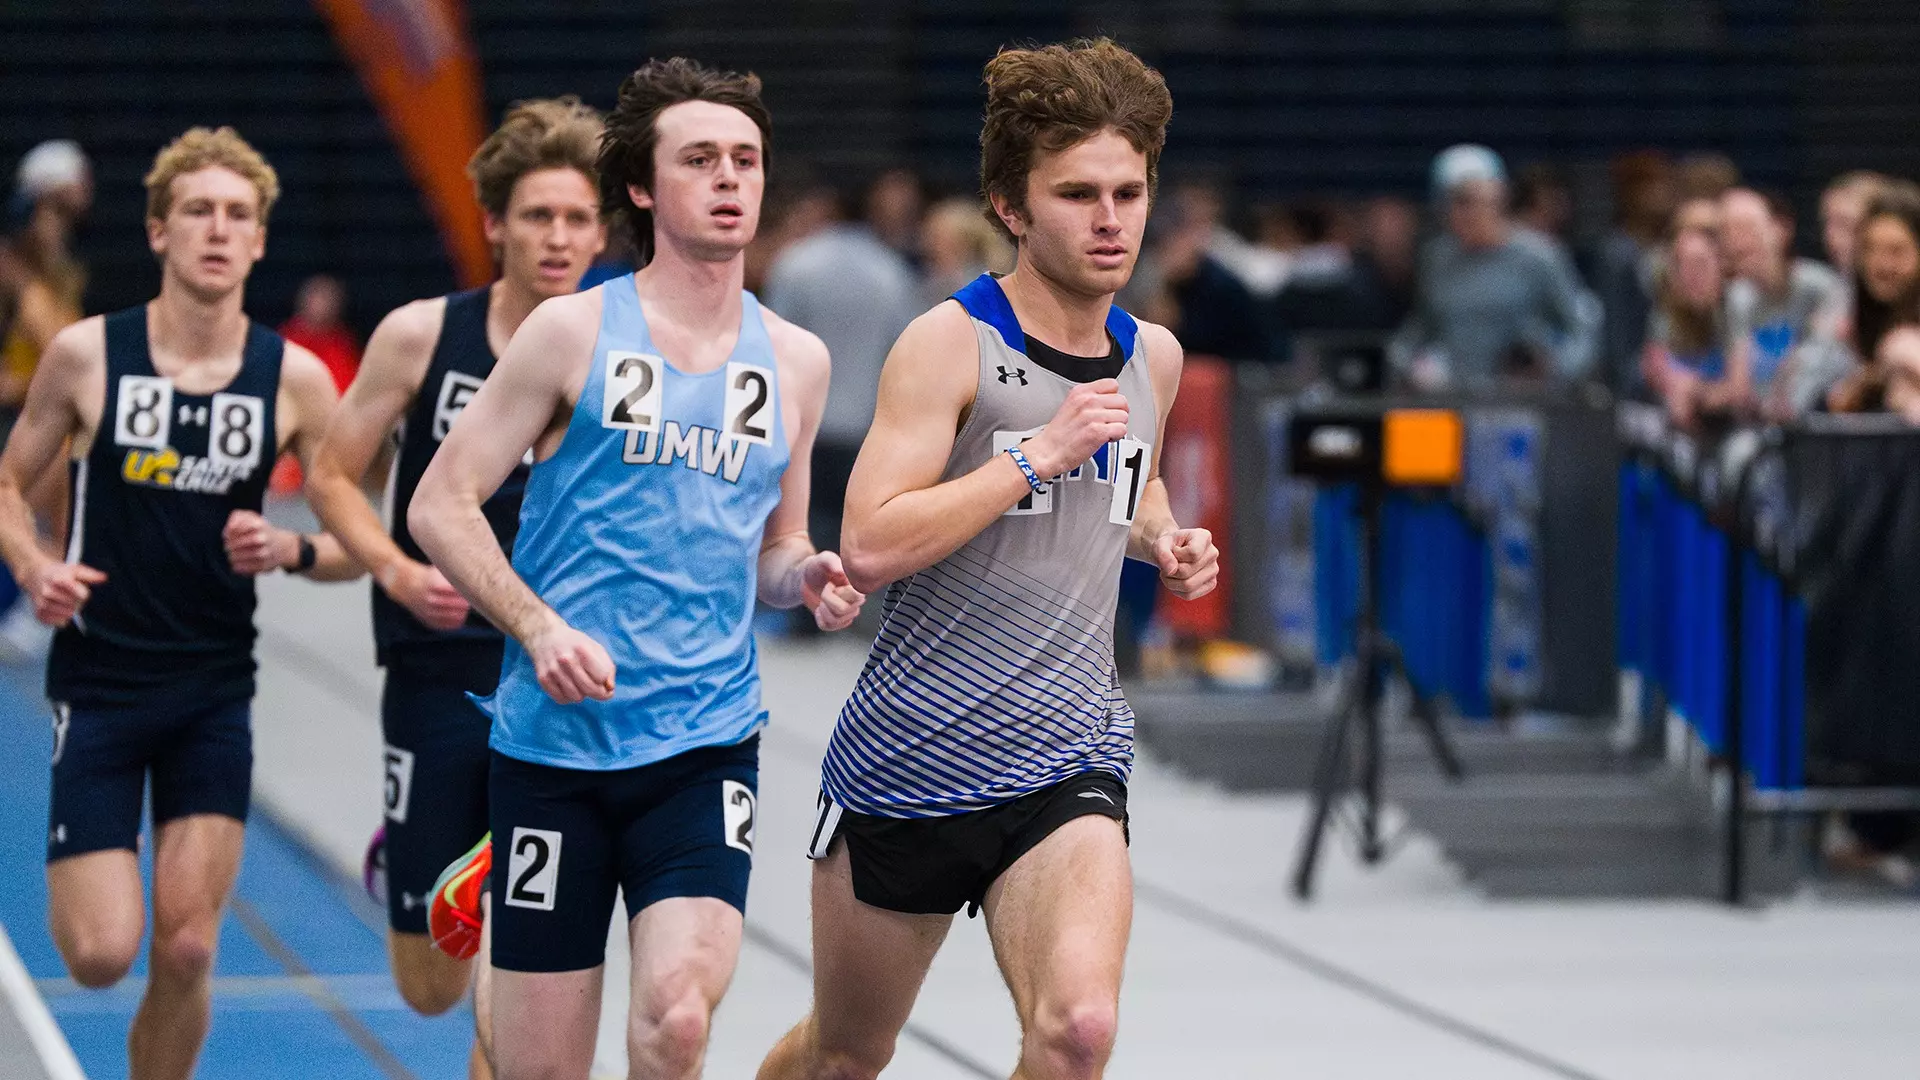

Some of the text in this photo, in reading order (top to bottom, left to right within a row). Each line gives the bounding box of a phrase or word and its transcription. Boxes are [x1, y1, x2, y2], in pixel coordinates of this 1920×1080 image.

[127, 381, 160, 437] 8
[611, 358, 653, 426] 2
[732, 370, 768, 439] 2
[219, 404, 252, 458] 8
[1124, 447, 1144, 521] 1
[731, 789, 753, 852] 2
[511, 834, 549, 903] 2
